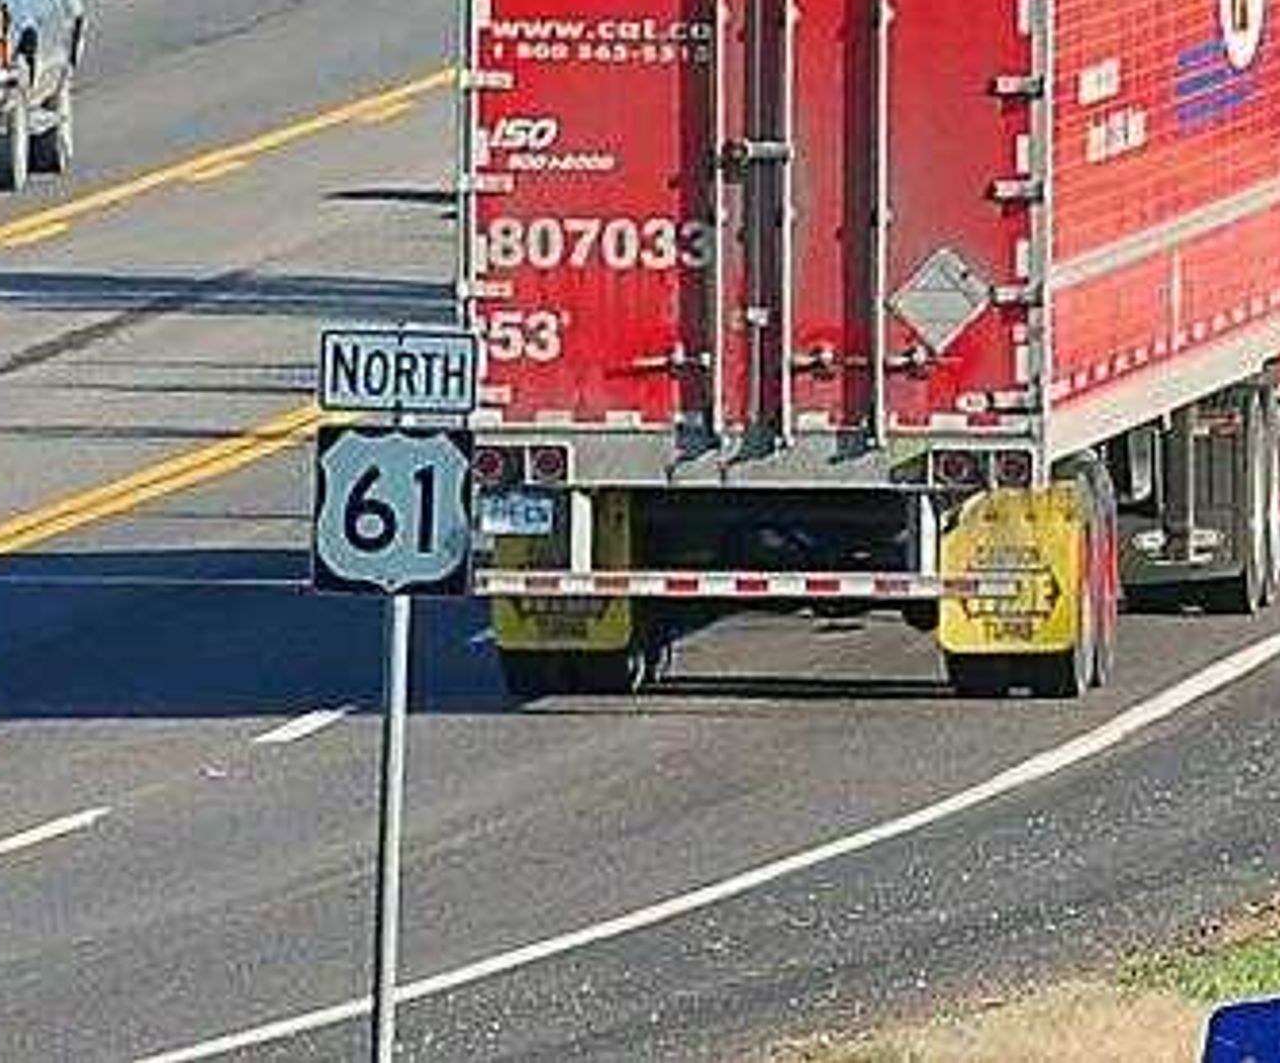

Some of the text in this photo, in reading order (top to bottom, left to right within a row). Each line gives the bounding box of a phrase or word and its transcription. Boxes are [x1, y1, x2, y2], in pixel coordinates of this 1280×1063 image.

[490, 118, 558, 148] ISO
[489, 218, 714, 269] 807033
[332, 342, 467, 398] NORTH
[344, 463, 436, 553] 61
